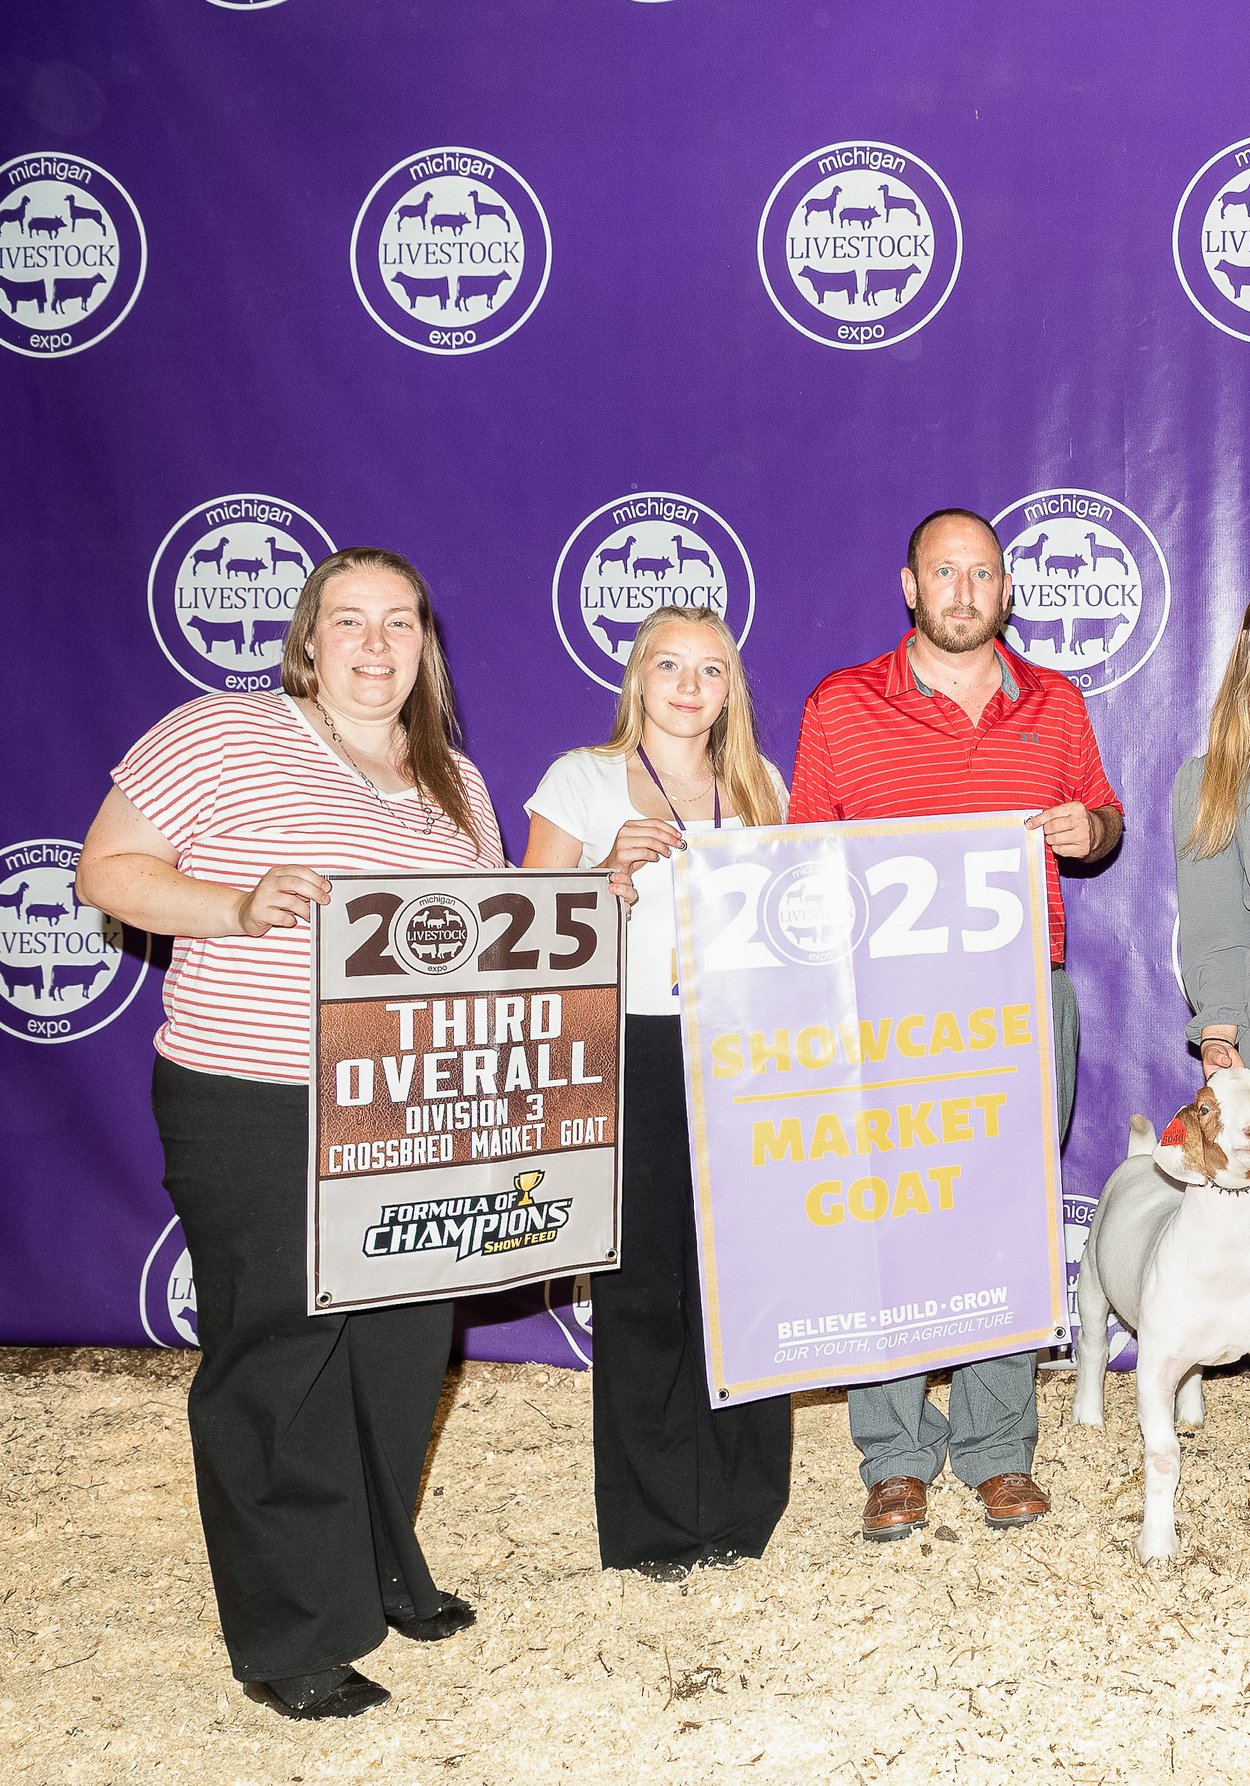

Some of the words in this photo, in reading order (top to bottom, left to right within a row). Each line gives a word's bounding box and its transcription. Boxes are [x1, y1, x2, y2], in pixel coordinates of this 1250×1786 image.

[8, 158, 92, 184] michigan
[409, 153, 495, 181] michigan
[817, 147, 906, 175] michigan
[0, 245, 116, 268] IVESTOCK
[382, 241, 521, 265] LIVESTOCK
[789, 234, 930, 259] LIVESTOCK
[30, 333, 72, 352] expo
[429, 329, 477, 349] expo
[837, 323, 885, 344] expo
[206, 499, 293, 527] michigan
[612, 498, 700, 525] michigan
[1024, 494, 1113, 522] michigan
[177, 587, 303, 610] LIVESTOC
[583, 586, 725, 610] LIVESTOCK
[1010, 583, 1139, 607] IVESTOCK
[225, 673, 271, 692] expo
[5, 845, 80, 870] michiga
[419, 896, 456, 906] michigan
[0, 931, 119, 954] VESTOCK
[407, 929, 466, 941] LIVESTOCK
[428, 965, 448, 974] expo
[27, 1018, 71, 1037] expo
[385, 993, 562, 1051] THIRD
[711, 1003, 1032, 1079] SHOWCASE
[336, 1041, 602, 1107] OVERALL
[405, 1098, 509, 1135] DIVISION
[526, 1093, 544, 1122] 3
[752, 1092, 1007, 1168] MARKET
[328, 1134, 453, 1173] CROSSBRED
[471, 1123, 546, 1159] MARKET
[560, 1116, 608, 1146] GOAT
[382, 1200, 492, 1226] FORMULA
[494, 1191, 520, 1209] OF
[805, 1165, 961, 1227] GOAT
[364, 1200, 570, 1260] CHAMPIONS
[484, 1237, 523, 1253] SHOW
[524, 1229, 558, 1245] FEED
[777, 1311, 867, 1340] BELIEVE
[879, 1299, 938, 1328] BUILD
[950, 1286, 1008, 1314] GROW
[773, 1344, 808, 1364] OUR
[813, 1338, 871, 1358] YOUTH,
[876, 1332, 909, 1351] OUR
[909, 1311, 1014, 1346] AGRICULTURE
